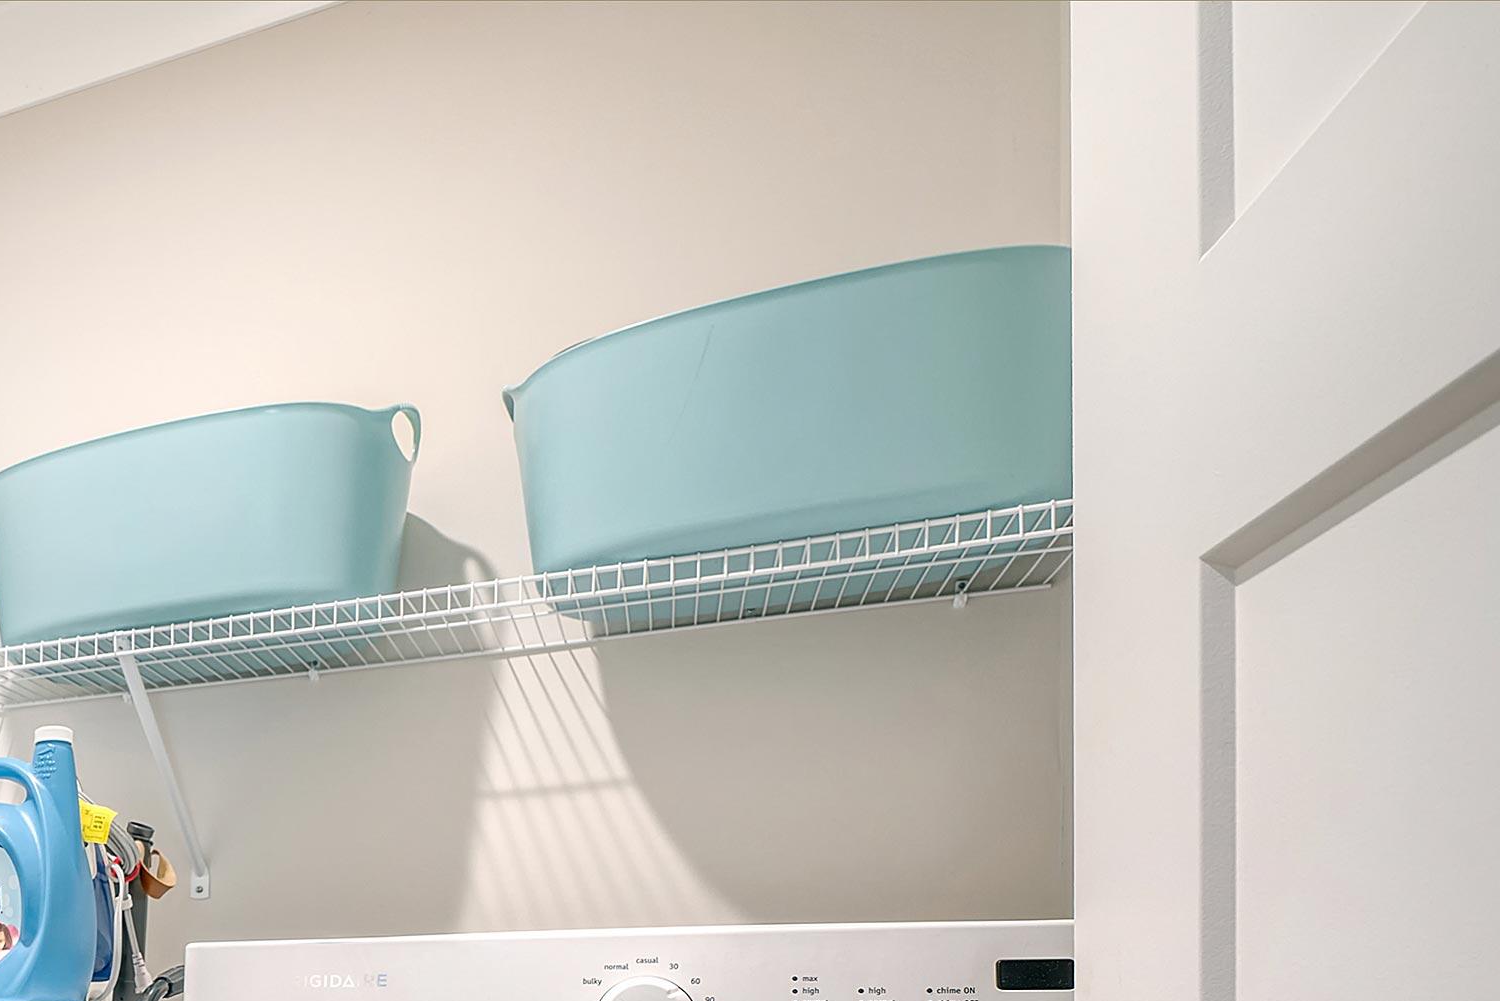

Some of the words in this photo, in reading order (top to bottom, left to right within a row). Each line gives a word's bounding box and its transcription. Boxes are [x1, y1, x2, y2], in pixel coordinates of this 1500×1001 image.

[583, 978, 602, 986] bulky
[802, 987, 820, 995] high
[868, 987, 886, 995] high
